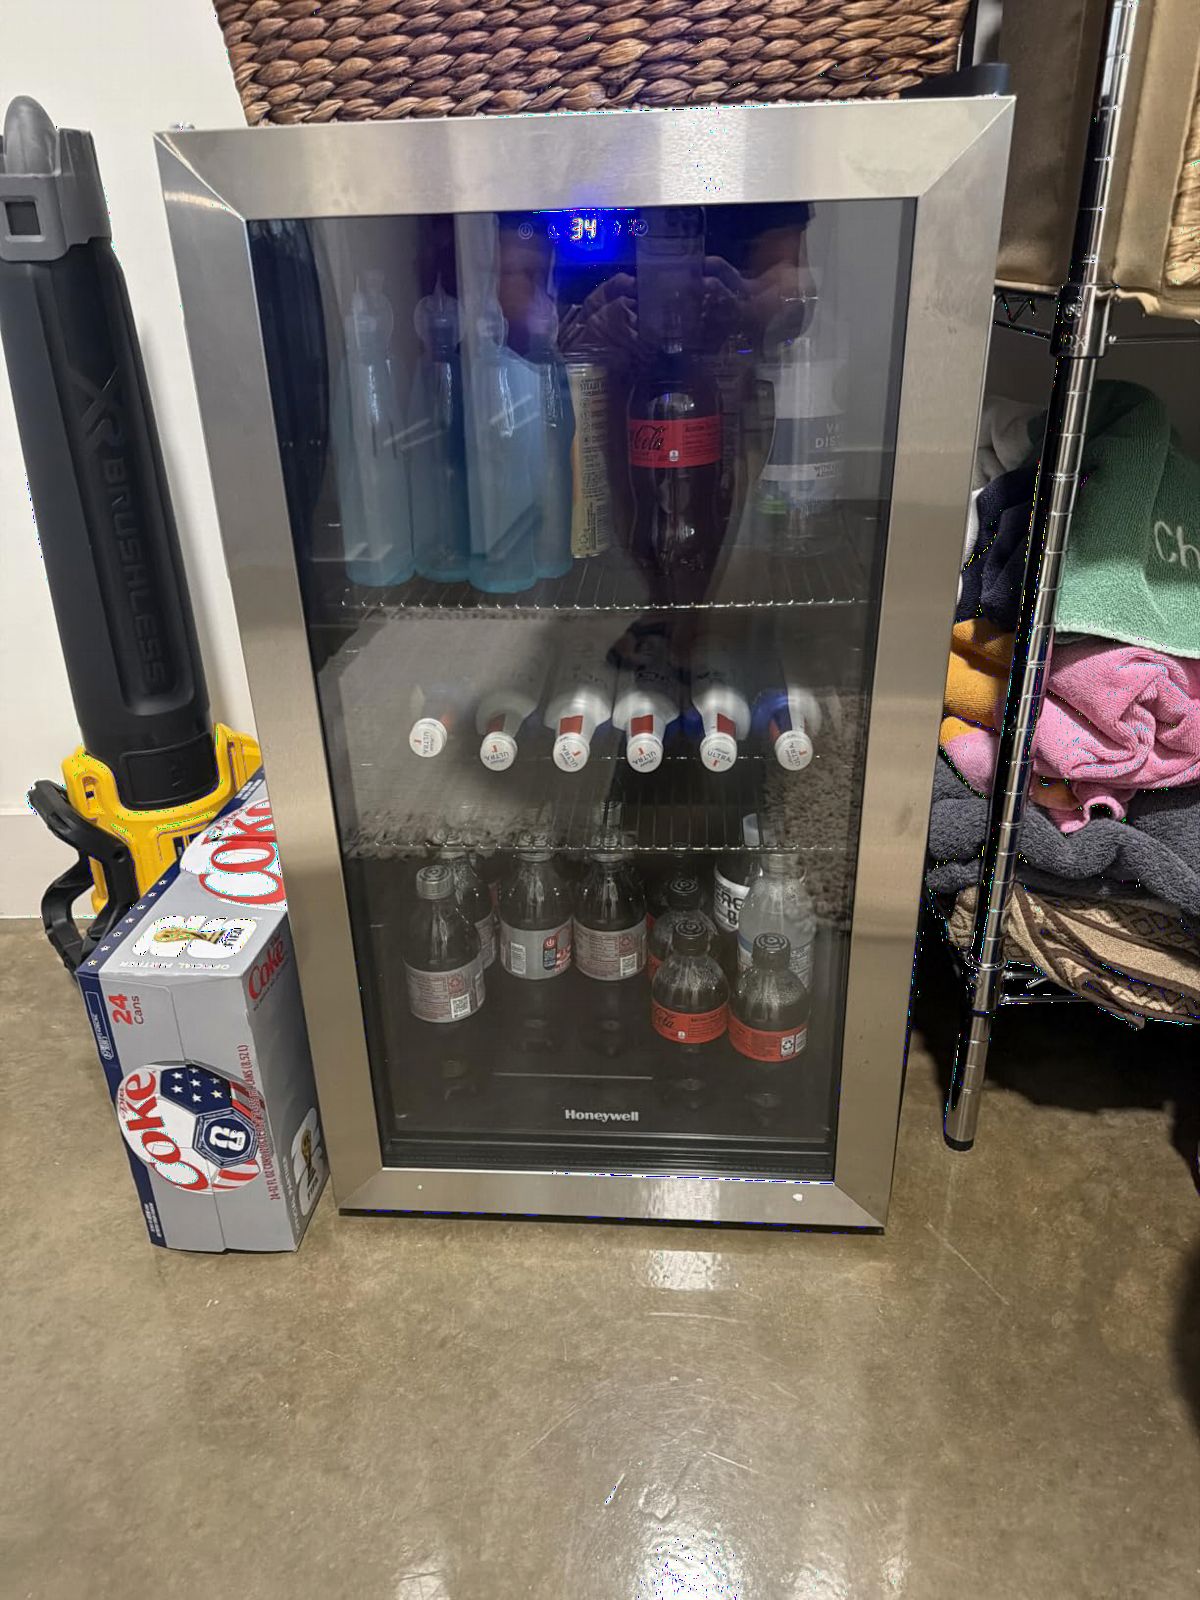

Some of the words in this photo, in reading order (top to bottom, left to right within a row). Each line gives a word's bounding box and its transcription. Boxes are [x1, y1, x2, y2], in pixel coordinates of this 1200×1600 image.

[572, 217, 597, 240] 34
[633, 424, 665, 451] Cola
[102, 456, 168, 690] BRUSHLESS
[707, 750, 732, 764] ULTRA
[248, 940, 284, 1000] Coke
[108, 994, 133, 1025] 24
[132, 995, 144, 1025] Cans
[565, 1109, 639, 1123] Honeywell
[125, 1073, 209, 1191] Coke
